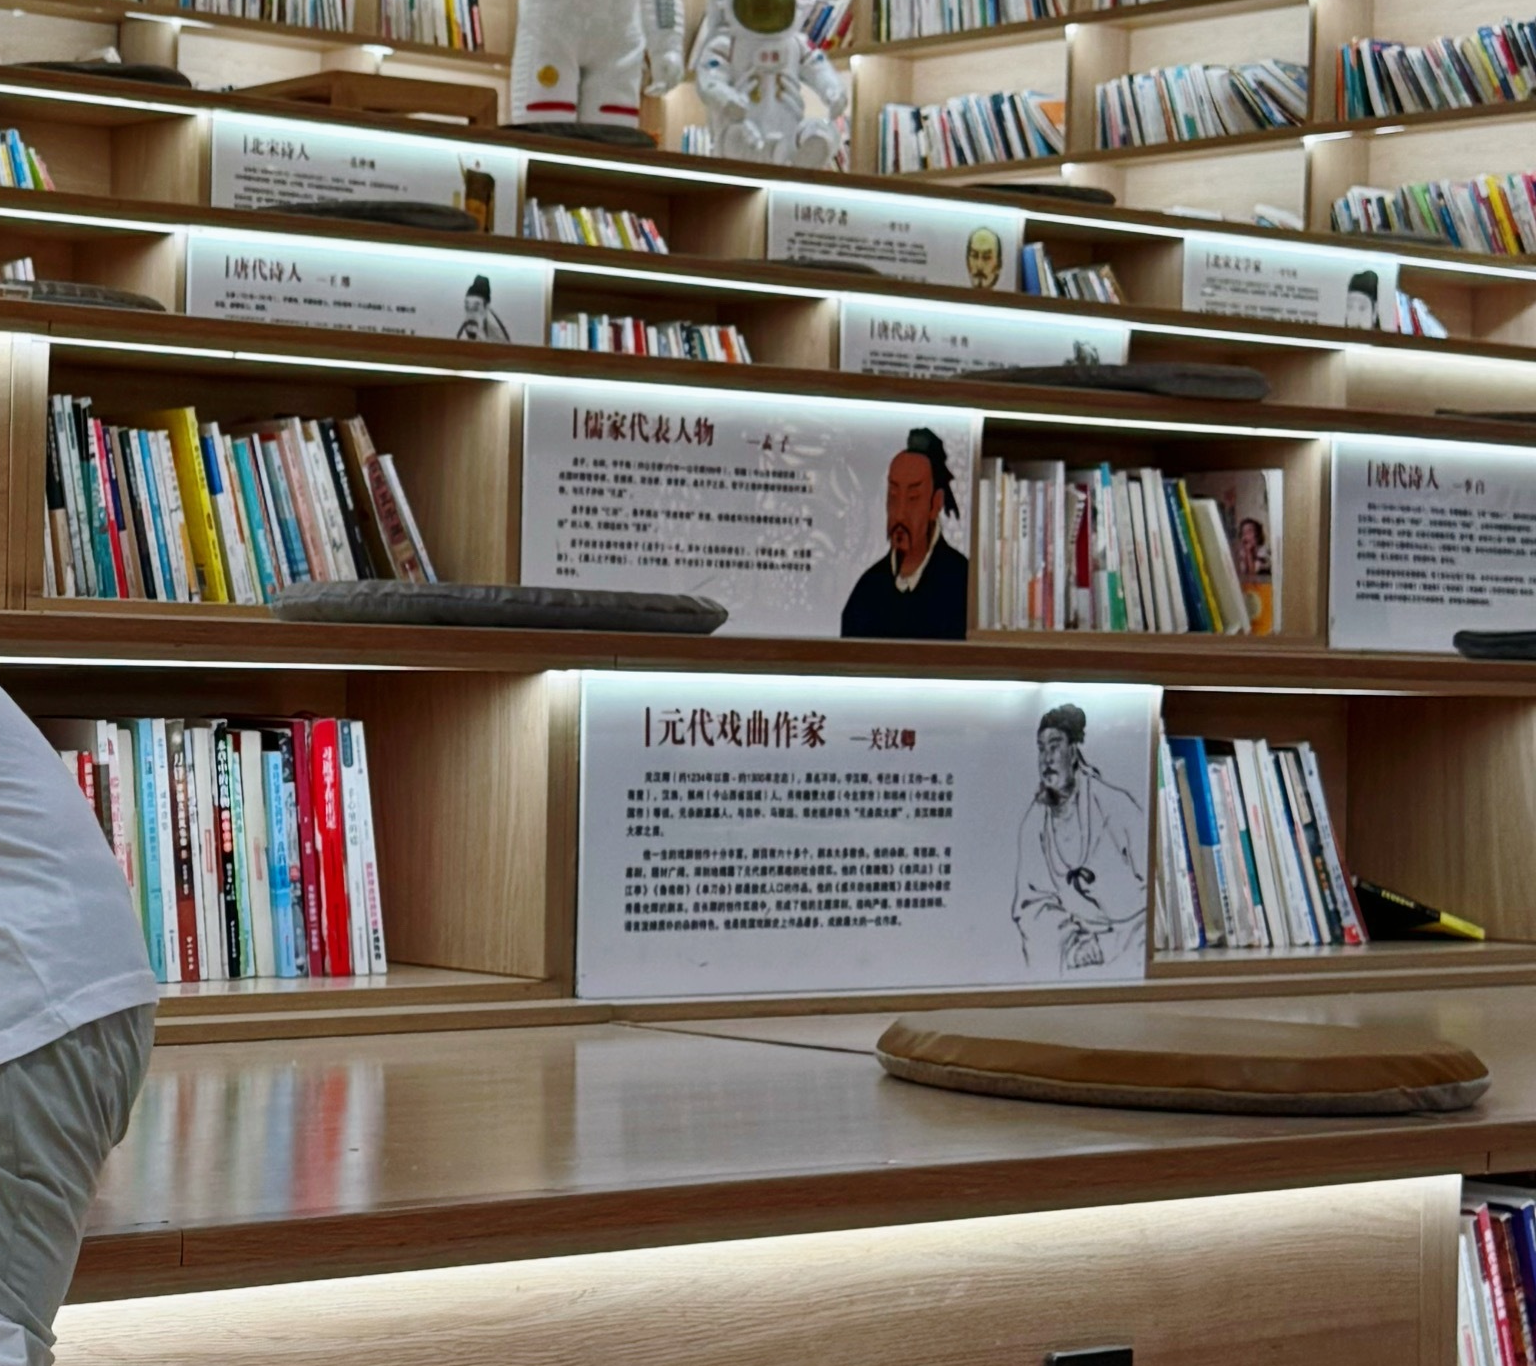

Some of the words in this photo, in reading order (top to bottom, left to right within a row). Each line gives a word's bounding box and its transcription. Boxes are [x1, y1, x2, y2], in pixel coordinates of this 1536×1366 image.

[234, 257, 302, 283] 唐代诗人
[584, 410, 714, 447] 儒家代表人物
[1376, 461, 1440, 491] 唐代诗人
[658, 708, 826, 749] 元代戏曲作家
